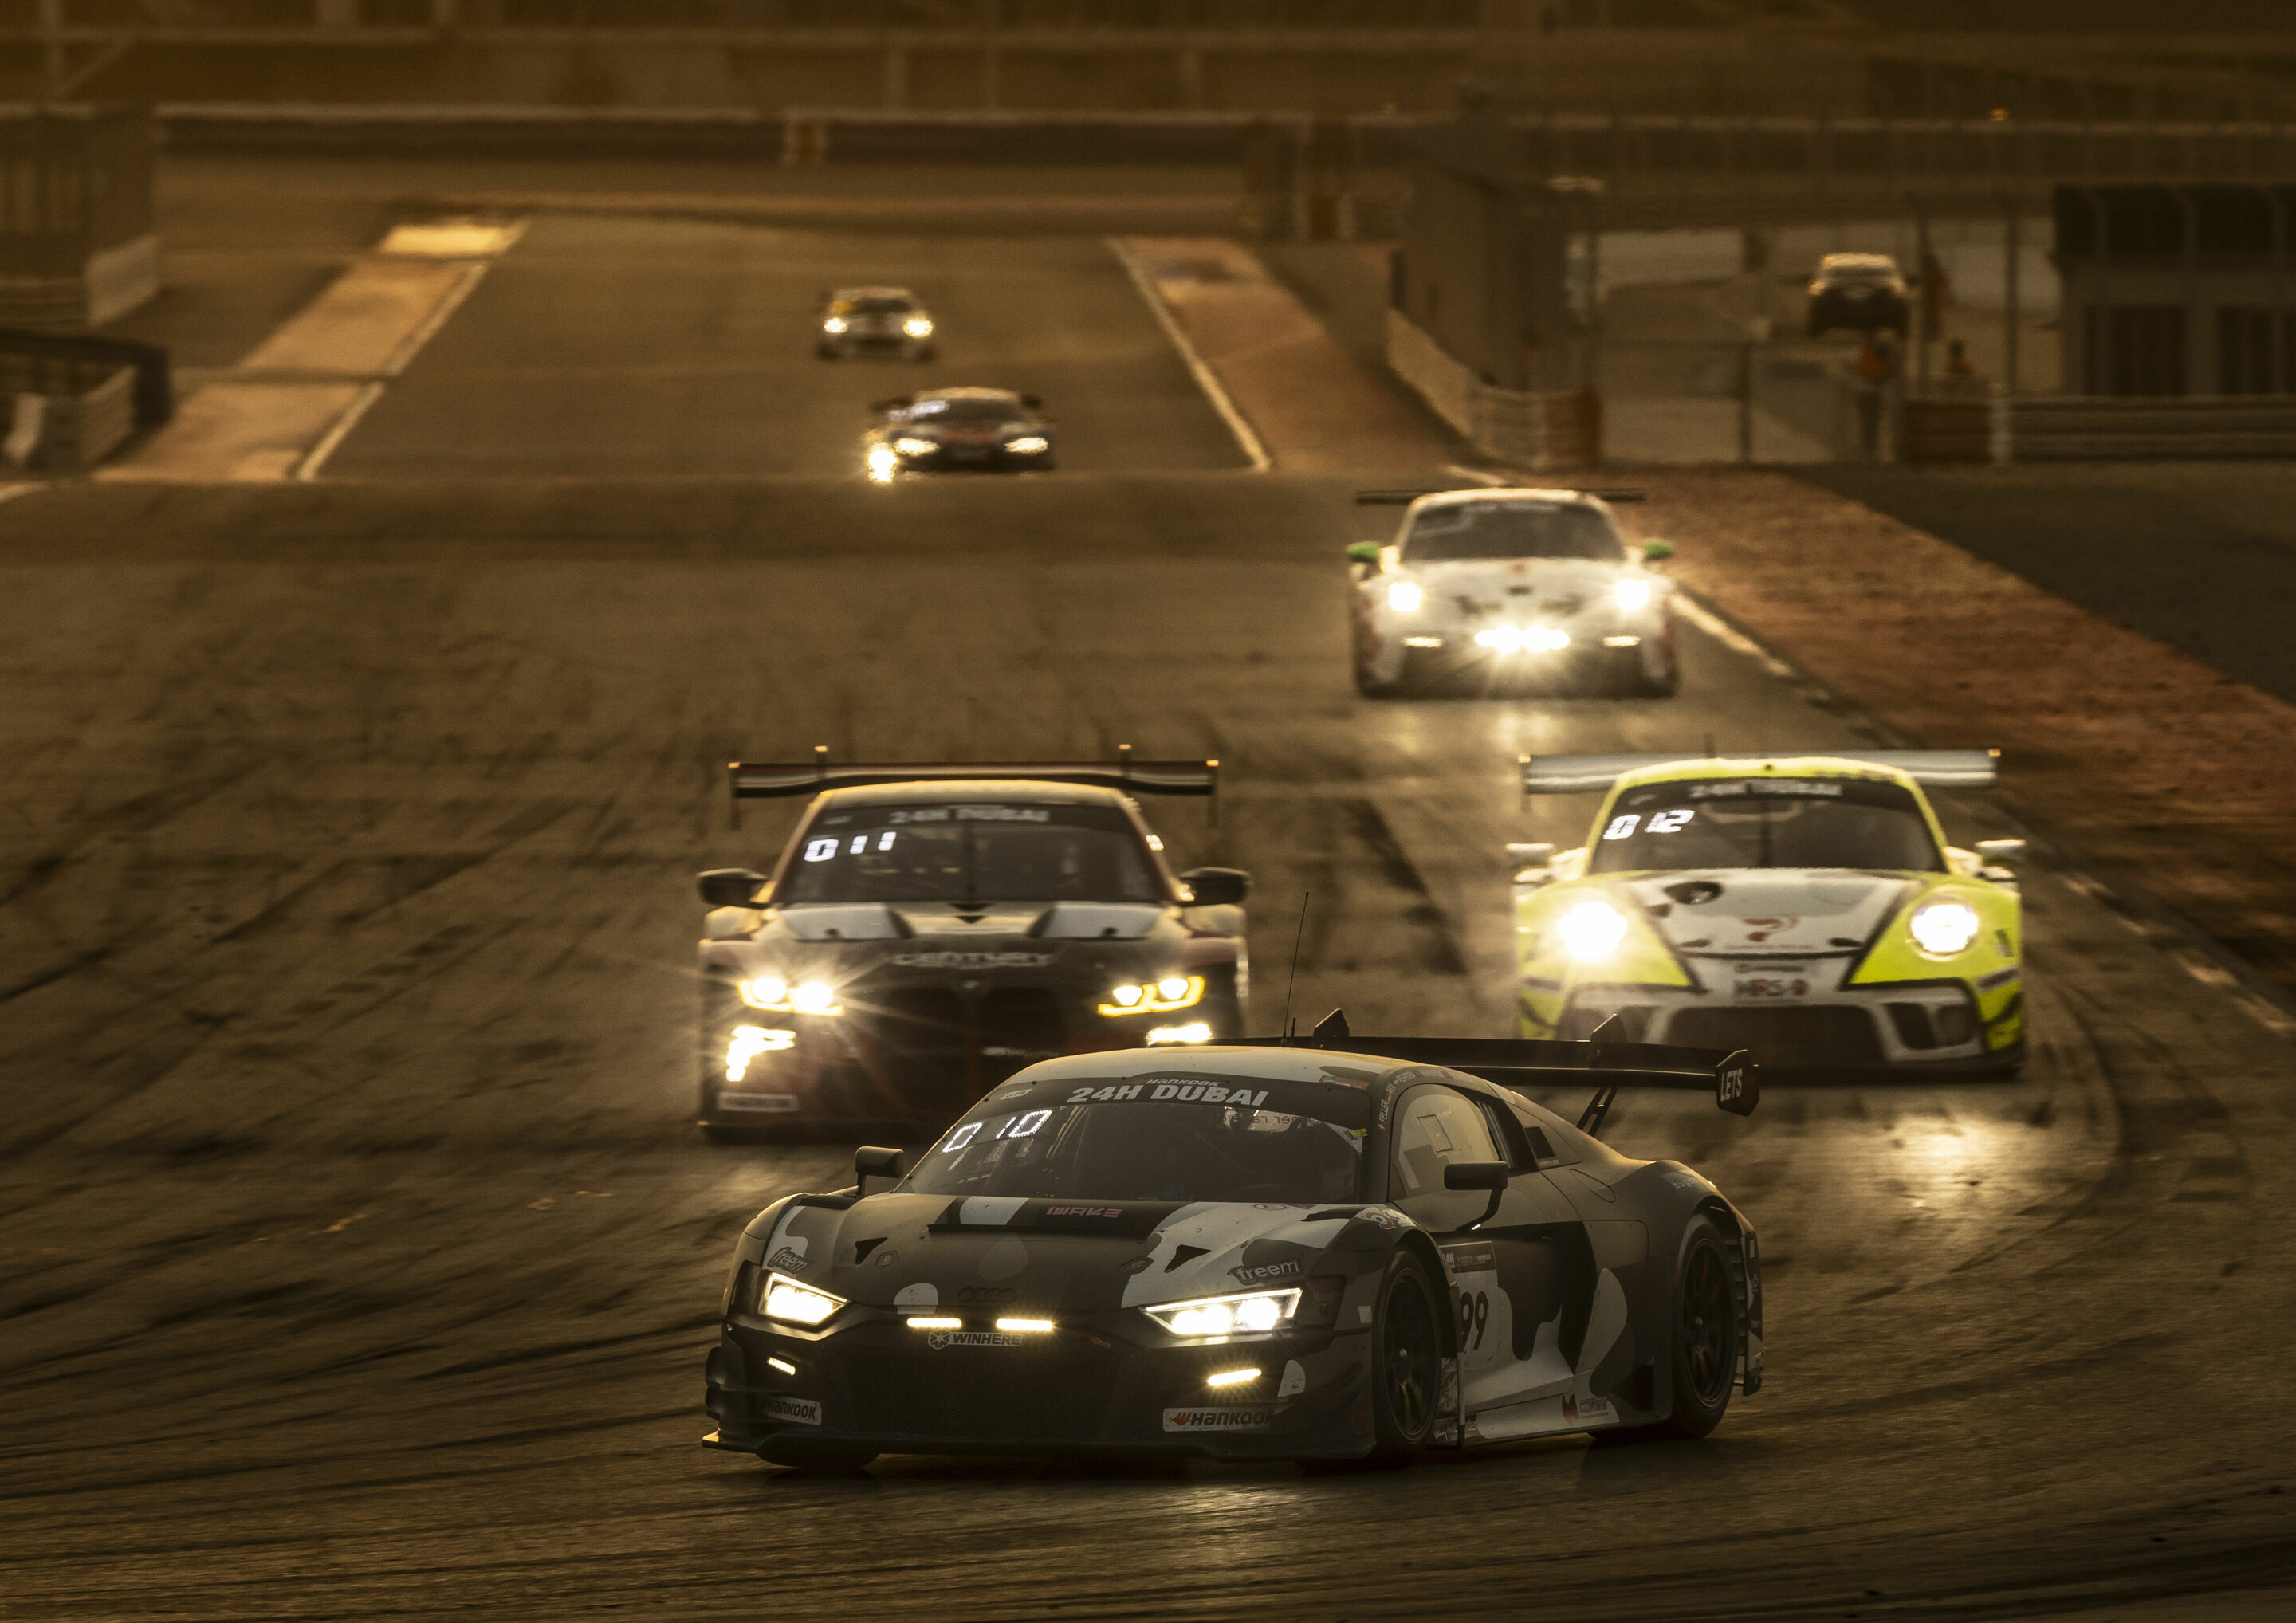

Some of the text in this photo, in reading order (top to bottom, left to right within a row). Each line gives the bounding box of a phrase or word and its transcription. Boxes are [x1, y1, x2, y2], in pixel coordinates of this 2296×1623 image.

[1066, 1084, 1269, 1106] 24H DUBAI
[1720, 1068, 1744, 1102] LETS
[771, 1248, 808, 1271] freem
[1236, 1261, 1299, 1281] freem
[953, 1333, 1022, 1346] WINHERE
